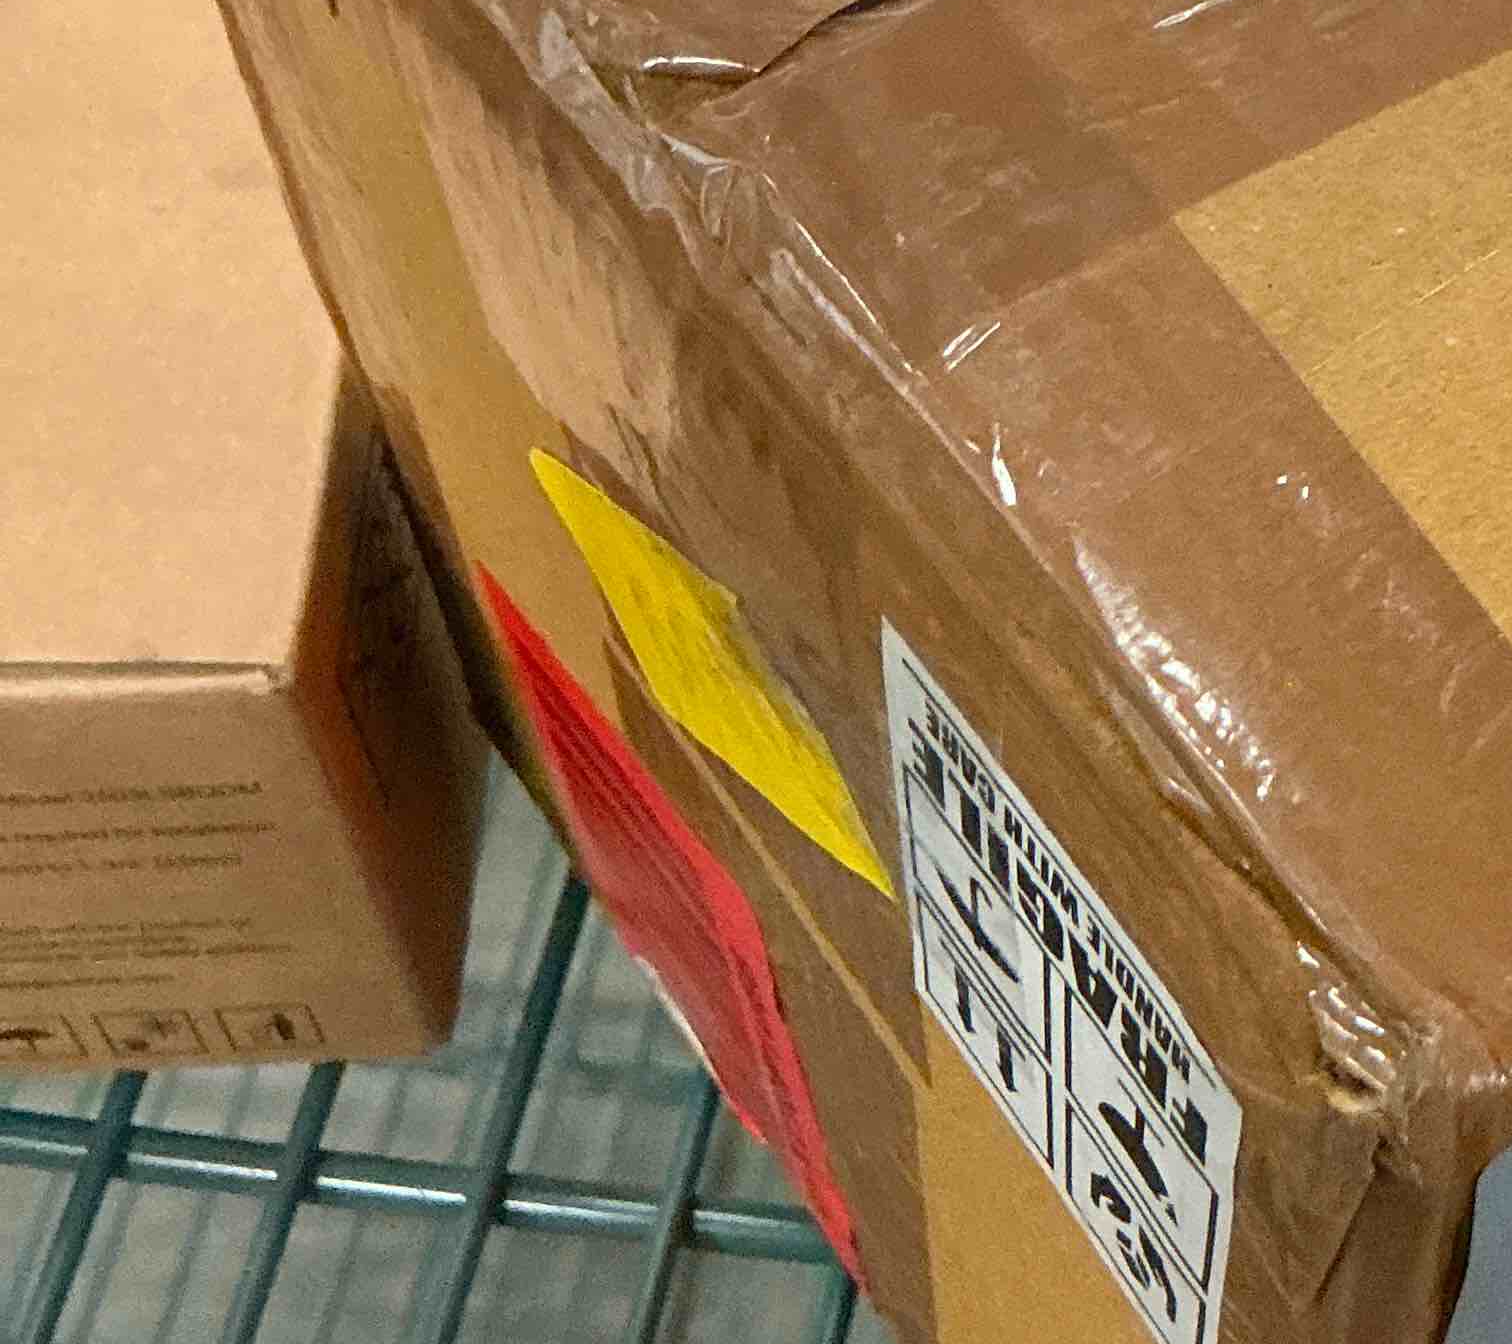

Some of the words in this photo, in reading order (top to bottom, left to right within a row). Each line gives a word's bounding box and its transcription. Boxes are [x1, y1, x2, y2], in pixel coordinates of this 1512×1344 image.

[923, 698, 996, 816] CARE
[1003, 803, 1080, 929] WITH
[907, 716, 1209, 1168] FRAGILE
[1086, 912, 1191, 1085] HANDLE
